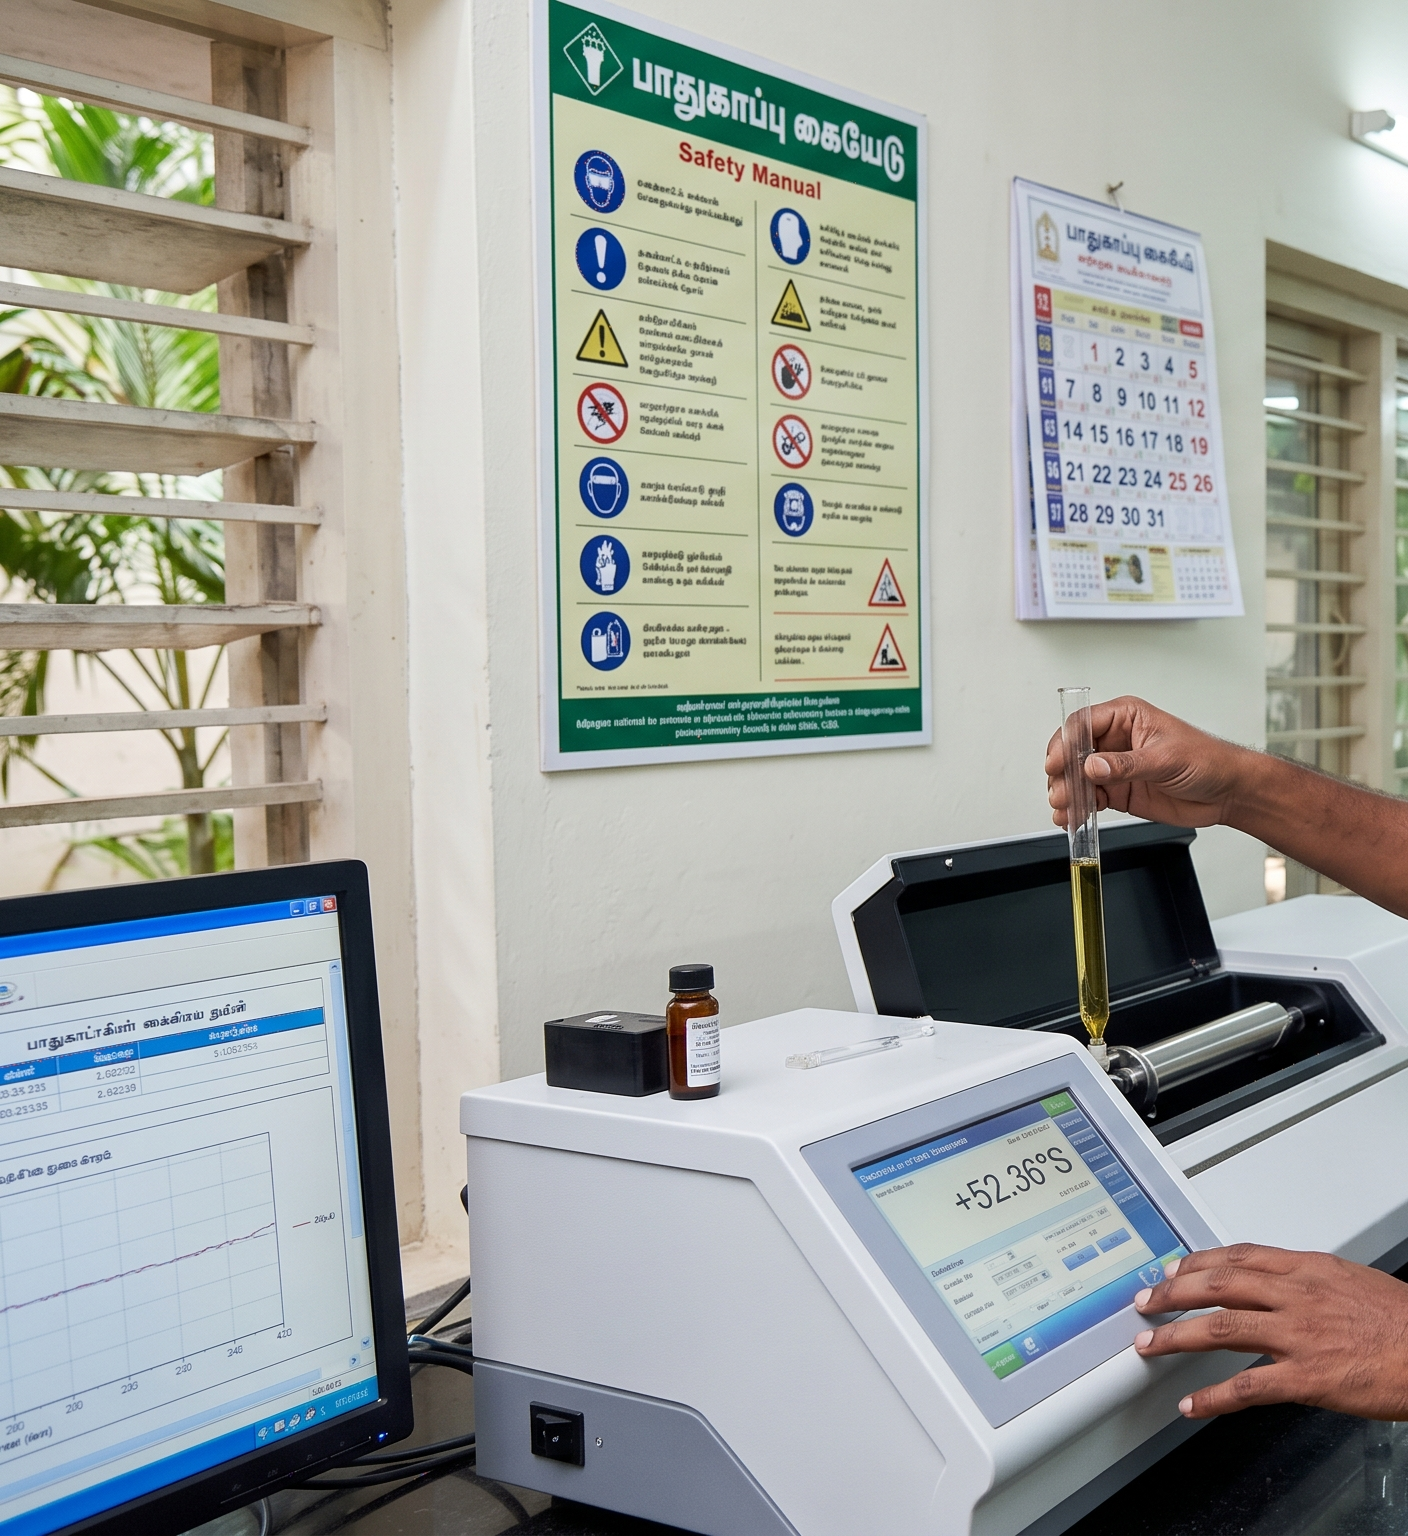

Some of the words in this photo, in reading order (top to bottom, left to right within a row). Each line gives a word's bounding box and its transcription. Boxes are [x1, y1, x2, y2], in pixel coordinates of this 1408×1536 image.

[632, 57, 786, 145] பாதுகாப்பு
[794, 113, 905, 183] கையேடு
[679, 141, 745, 183] Safety
[752, 163, 822, 200] Manual
[1091, 342, 1098, 362] 1
[1115, 347, 1125, 366] 2
[1140, 352, 1150, 371] 3
[1164, 356, 1174, 375] 4
[1188, 360, 1198, 379] 5
[1066, 379, 1075, 398] 7
[1092, 383, 1102, 403] 8
[1117, 387, 1127, 406] 9
[1138, 391, 1156, 411] 10
[1164, 395, 1180, 414] 11
[1188, 399, 1205, 418] 12
[1063, 420, 1083, 441] 14
[1090, 424, 1109, 444] 15
[1116, 427, 1134, 447] 16
[1141, 430, 1158, 450] 17
[1165, 434, 1184, 453] 18
[1190, 437, 1208, 456] 19
[1066, 461, 1084, 482] 21
[1092, 464, 1111, 485] 22
[1118, 467, 1138, 487] 23
[1144, 469, 1162, 489] 24
[1169, 472, 1187, 491] 25
[1193, 474, 1213, 493] 26
[1069, 503, 1088, 523] 28
[1095, 505, 1114, 525] 29
[1121, 506, 1140, 526] 30
[1147, 508, 1164, 527] 31
[955, 1147, 1073, 1211] +52.36°S
